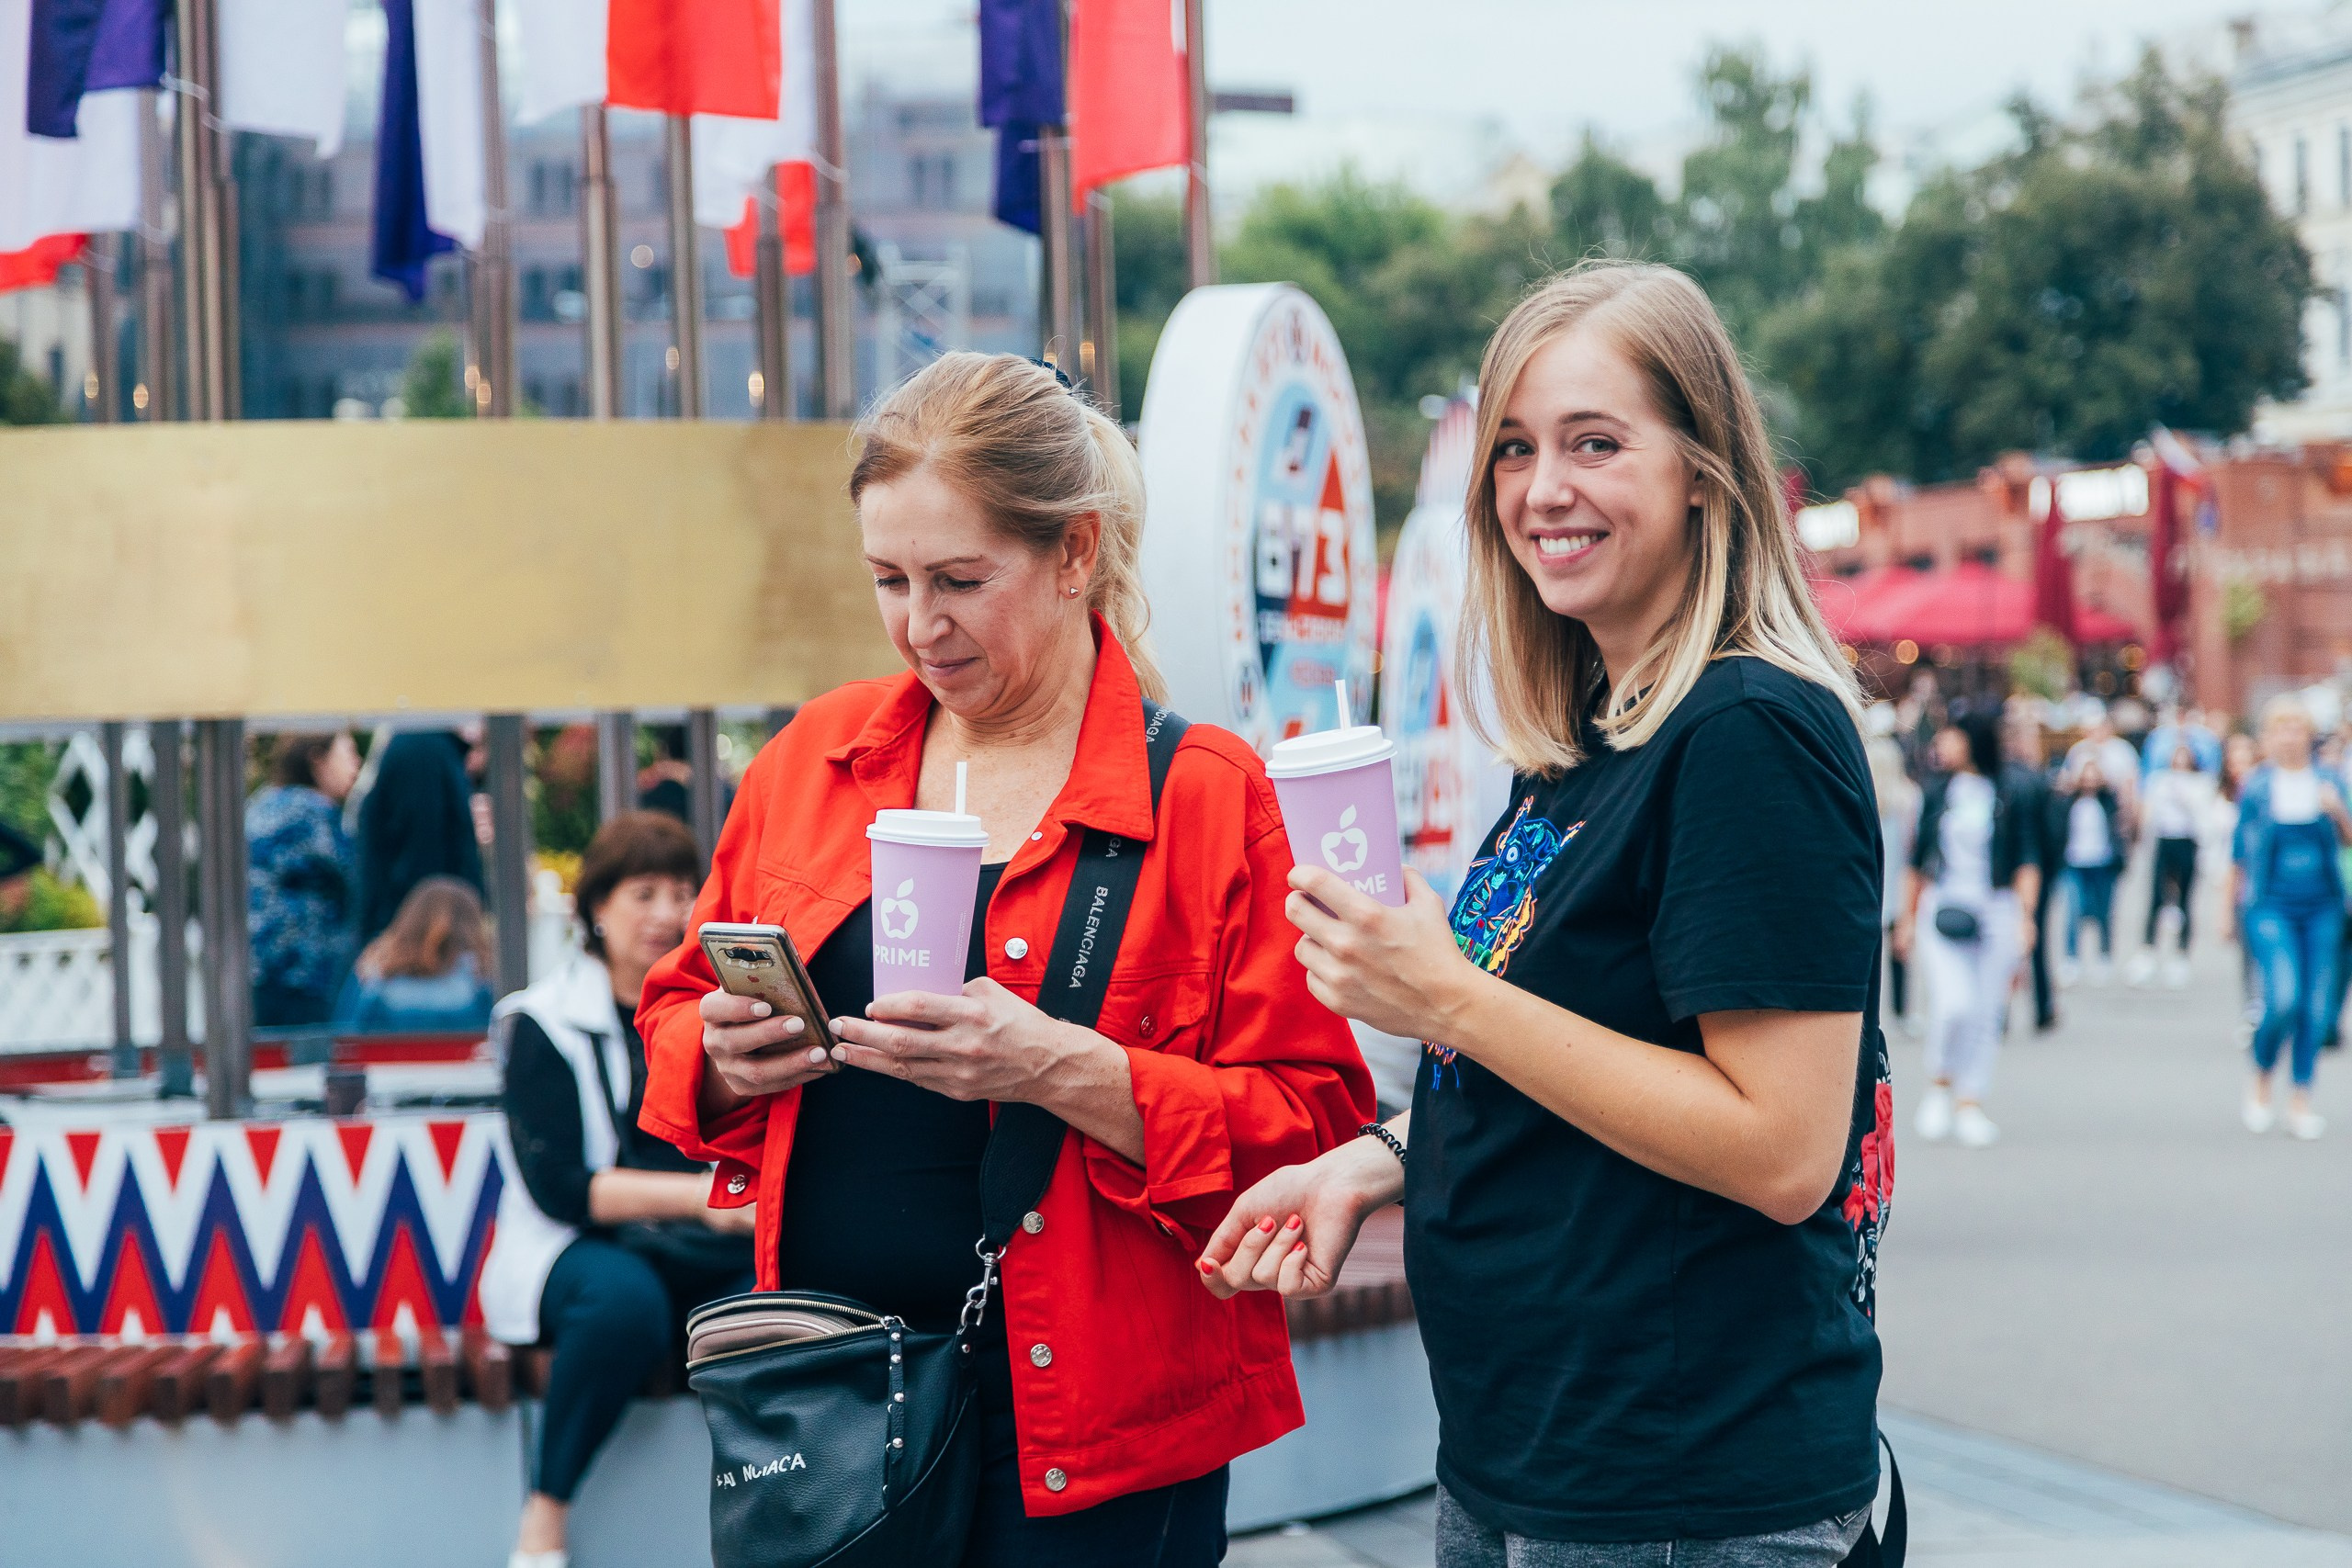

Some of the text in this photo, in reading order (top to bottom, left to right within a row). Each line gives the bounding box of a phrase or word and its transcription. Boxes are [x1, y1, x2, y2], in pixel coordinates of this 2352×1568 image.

[1145, 706, 1170, 743] NCIAGA
[875, 944, 931, 967] PRIME
[1069, 886, 1109, 989] BALENCIAGA
